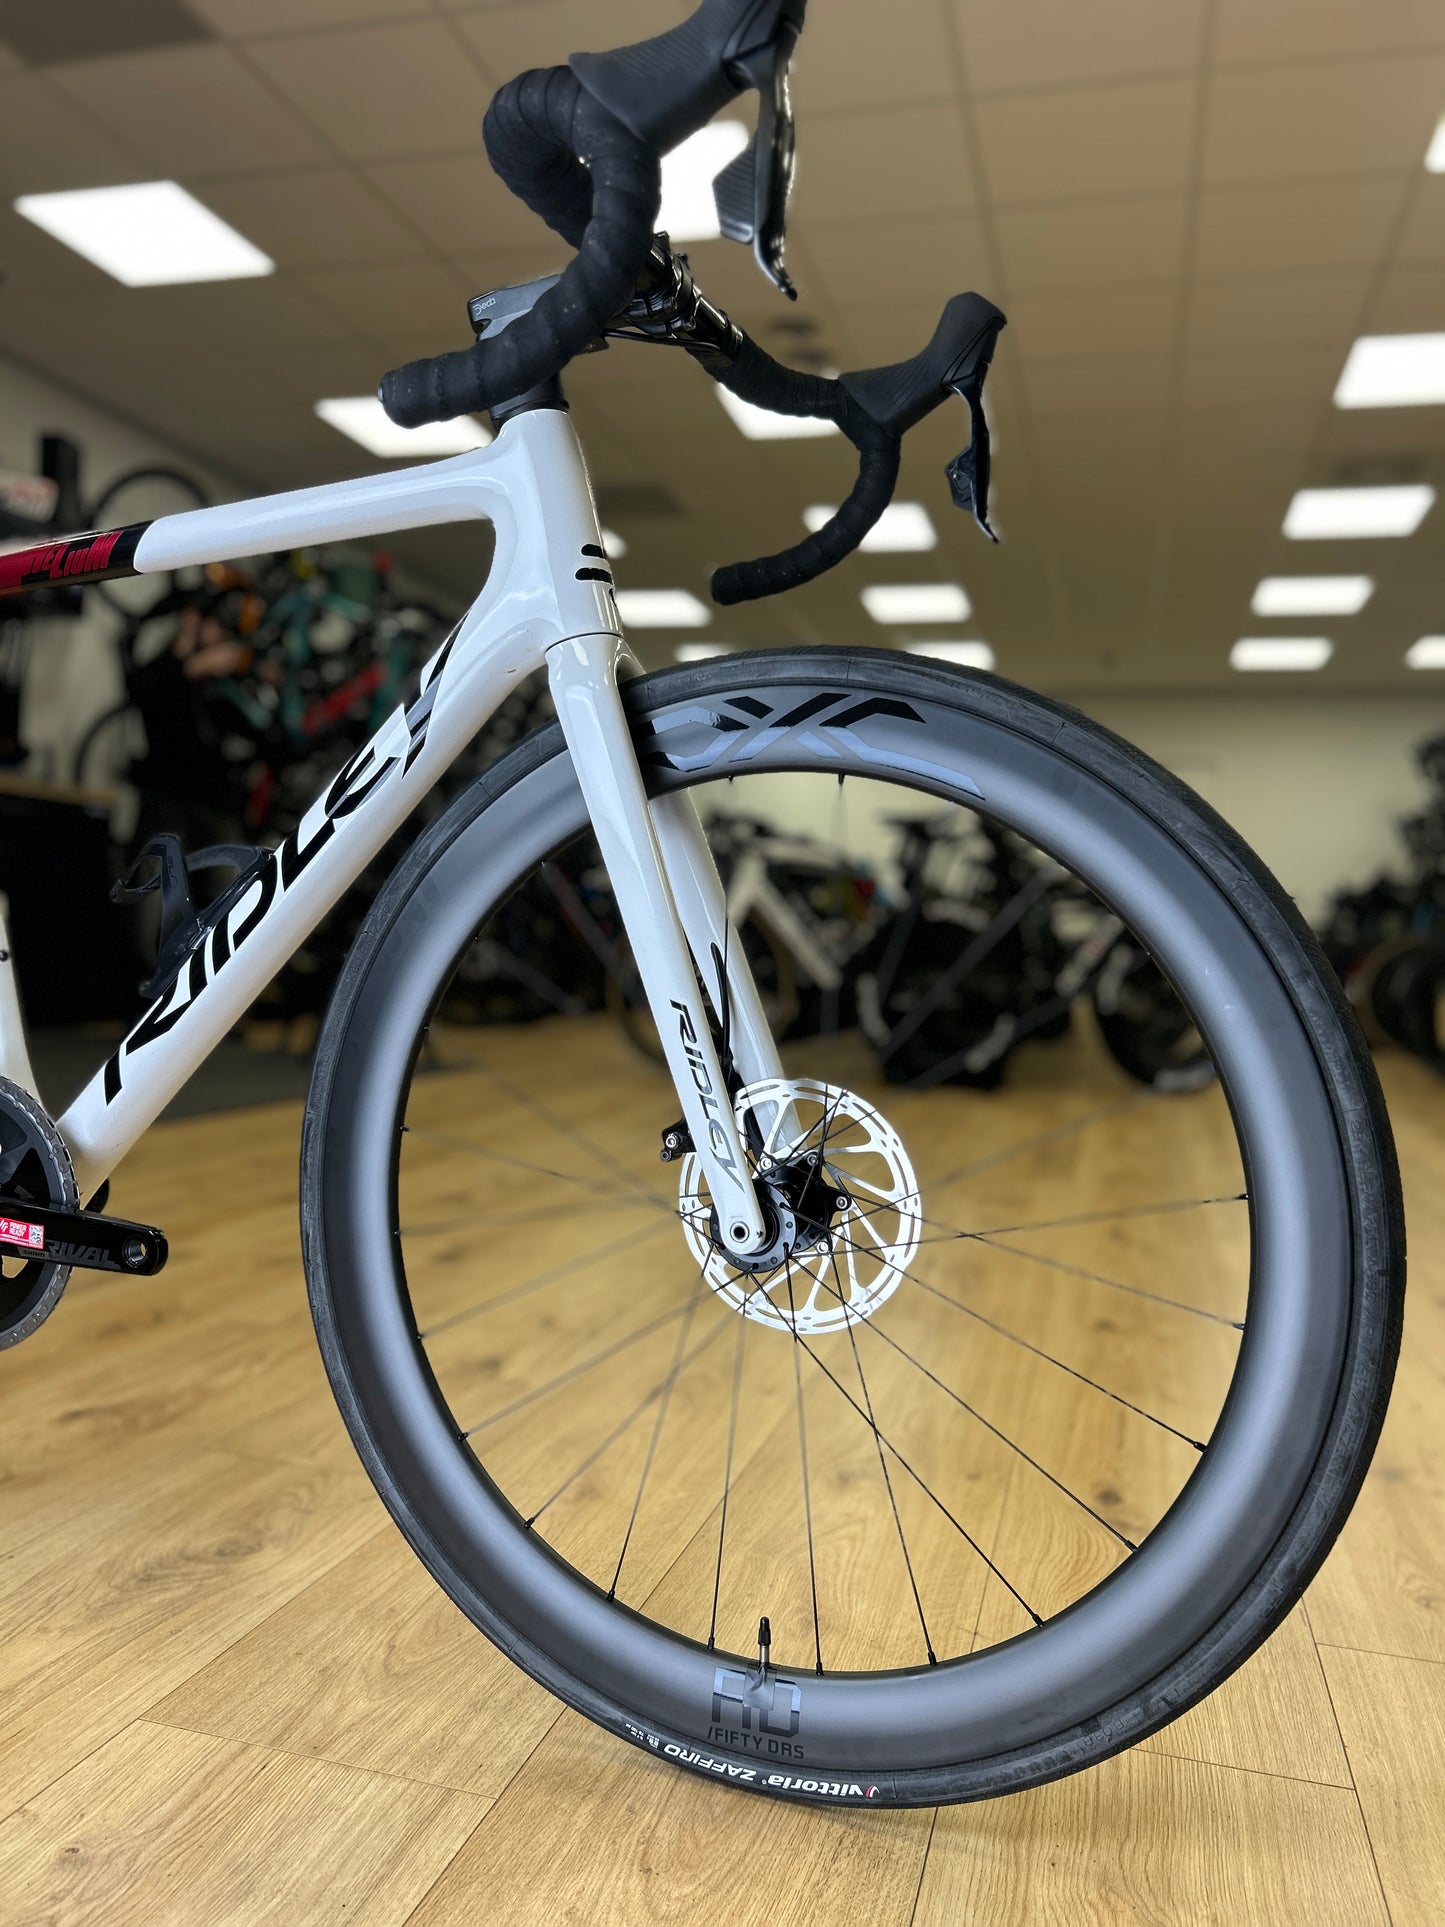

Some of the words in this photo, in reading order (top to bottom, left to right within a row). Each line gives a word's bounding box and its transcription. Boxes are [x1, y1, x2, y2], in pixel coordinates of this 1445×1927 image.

[104, 615, 470, 1105] RIDLEY
[669, 999, 746, 1192] RIDLEY
[45, 1239, 117, 1264] RIVAL
[664, 1744, 757, 1781] ZAFFIRO
